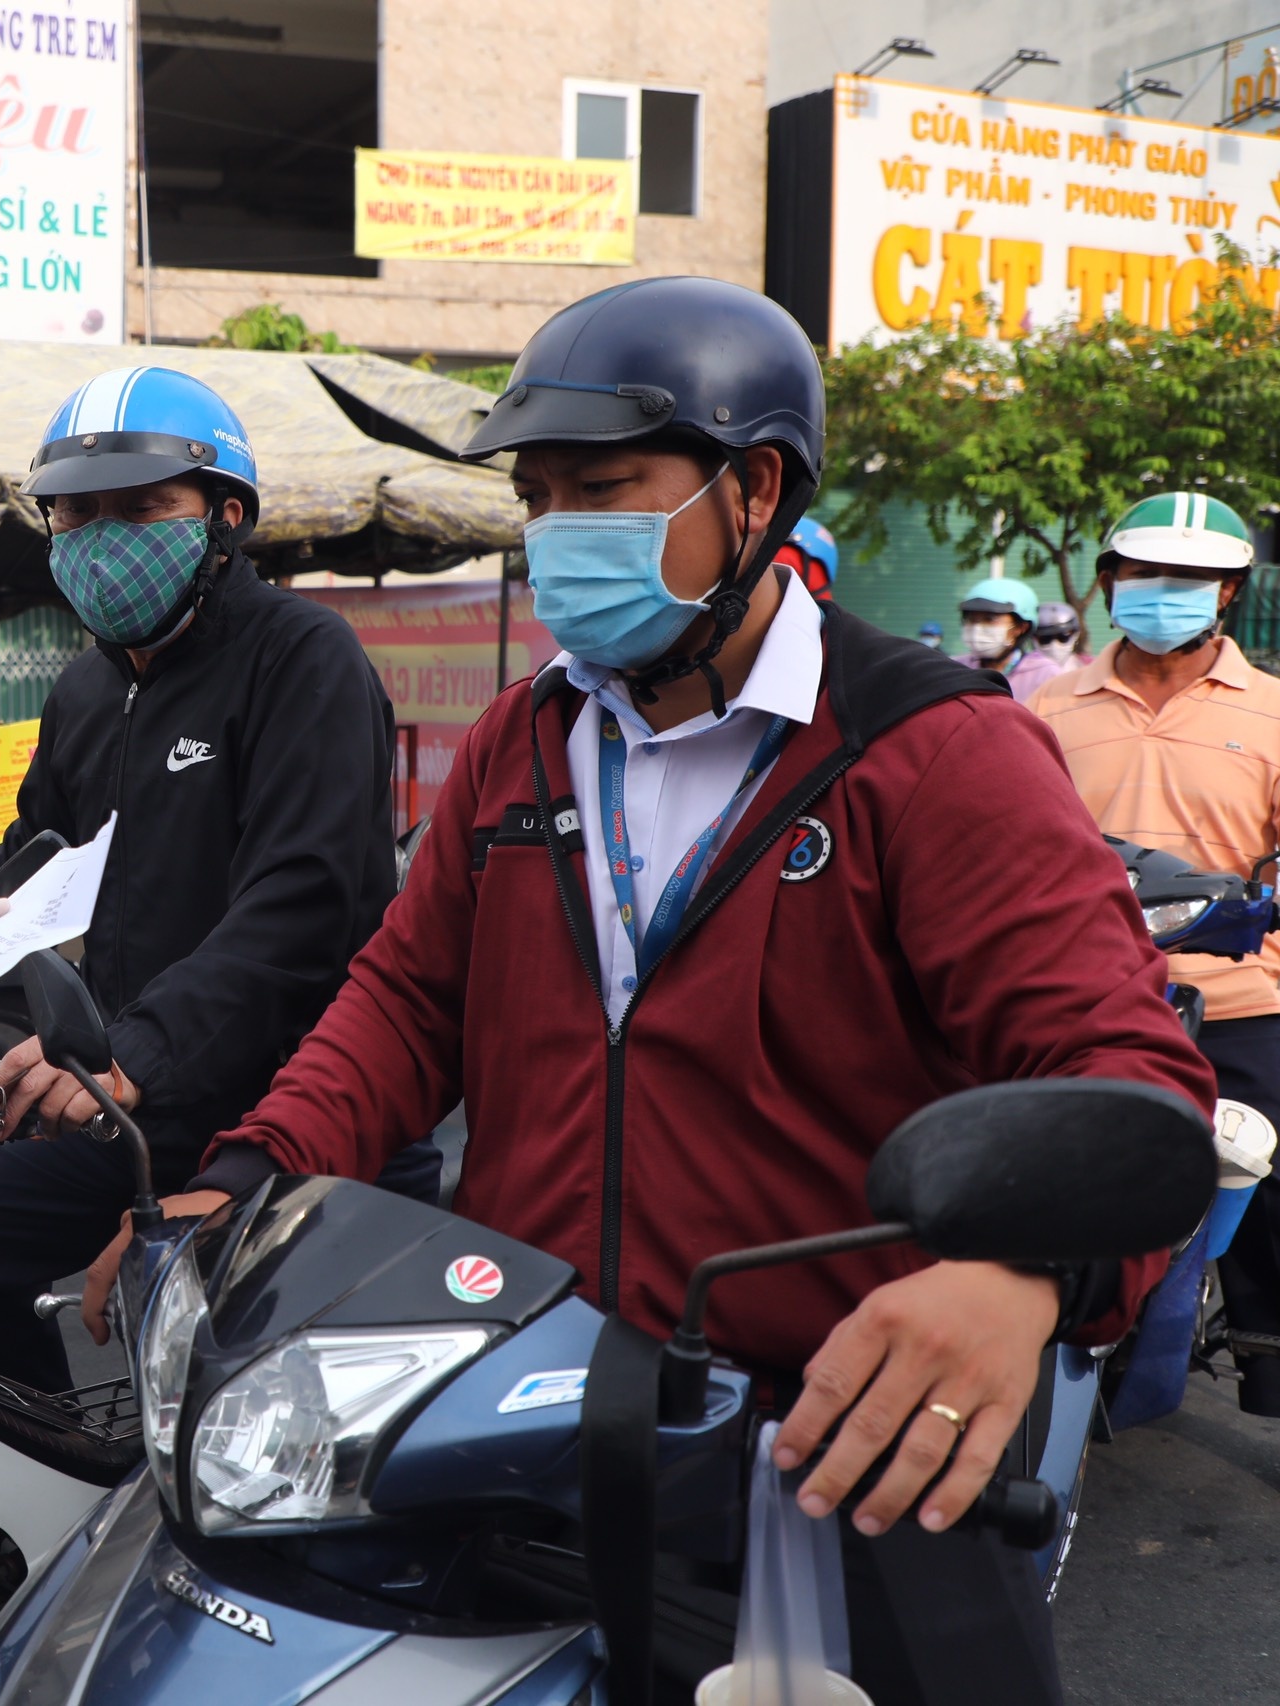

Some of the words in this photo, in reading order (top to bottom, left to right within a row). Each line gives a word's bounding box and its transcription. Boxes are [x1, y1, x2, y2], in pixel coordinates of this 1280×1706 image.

[86, 20, 116, 62] EM
[910, 102, 970, 148] CỬA
[981, 116, 1061, 159] HÀNG
[1068, 130, 1138, 175] PHẬT
[1145, 140, 1209, 179] GIÁO
[414, 162, 453, 190] THUÊ
[458, 164, 518, 192] NGUYÊN
[880, 154, 931, 199] VẬT
[945, 157, 1032, 206] PHẨM
[1064, 183, 1157, 221] PHONG
[1168, 190, 1238, 230] THỦY
[38, 200, 60, 235] &
[73, 192, 109, 238] LẺ
[365, 200, 417, 225] NGANG
[22, 249, 82, 293] LỚN
[872, 211, 1044, 341] CÁT
[175, 736, 211, 758] NIKE
[164, 1570, 274, 1644] HONDA
